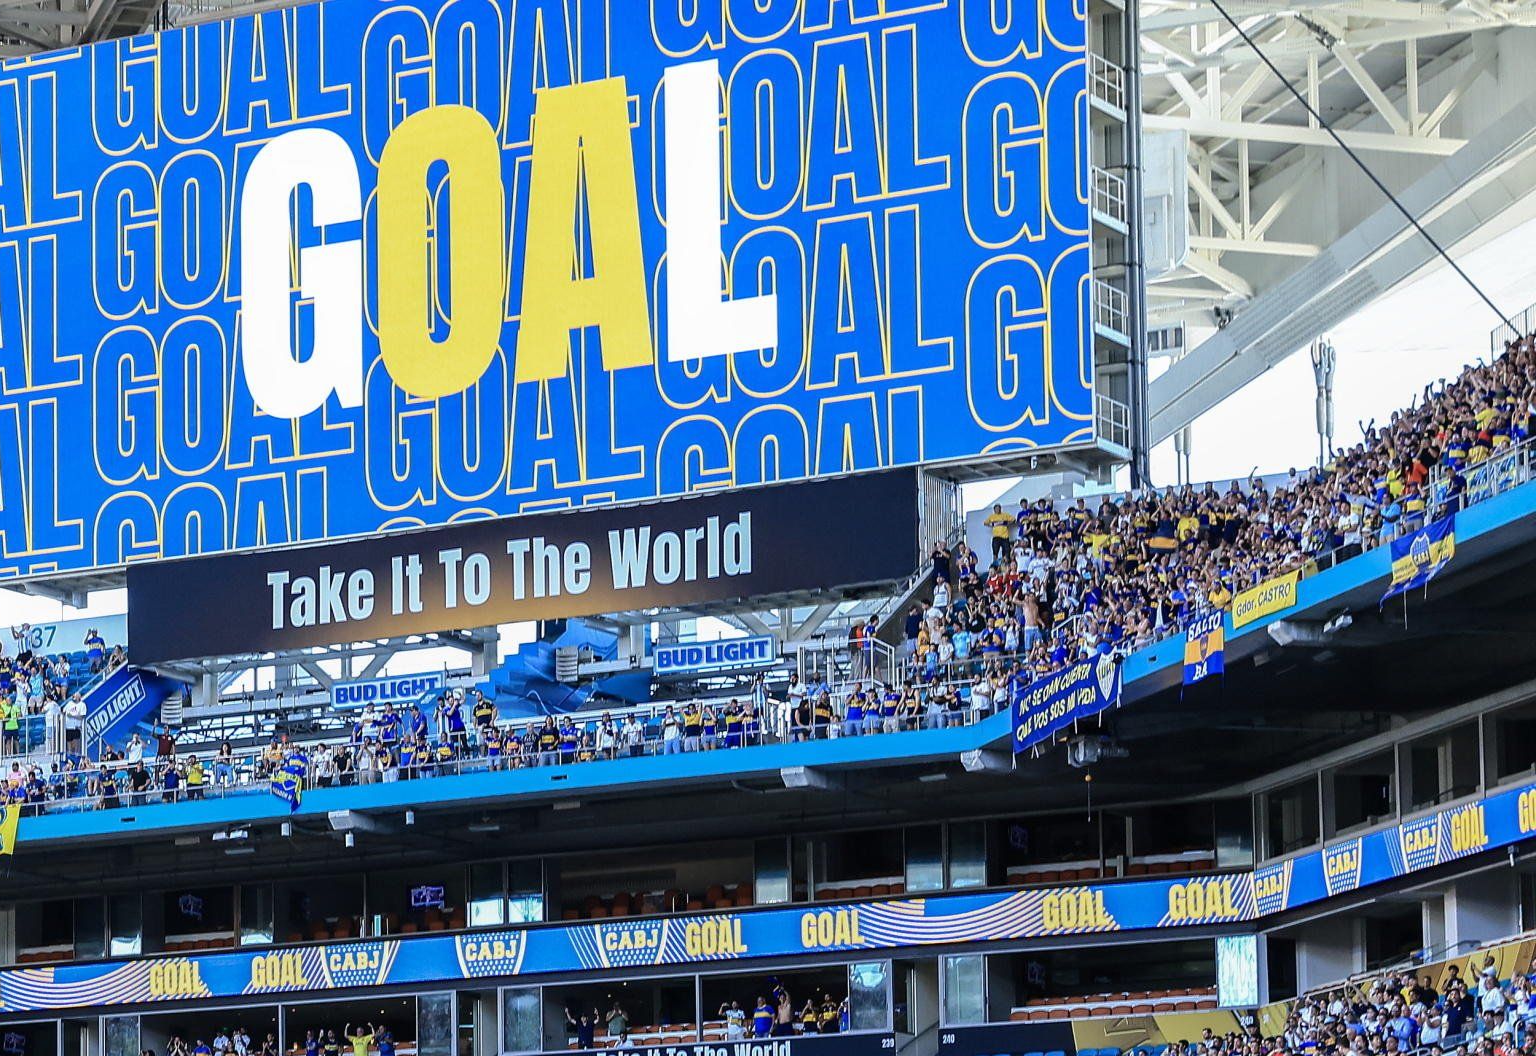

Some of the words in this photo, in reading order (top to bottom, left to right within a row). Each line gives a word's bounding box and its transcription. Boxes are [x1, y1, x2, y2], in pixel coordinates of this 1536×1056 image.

[241, 58, 778, 418] GOAL
[267, 563, 374, 630] Take
[392, 553, 422, 616] It
[439, 548, 490, 609] To
[506, 536, 591, 600] The
[608, 511, 753, 590] World
[1258, 582, 1291, 606] CASTRO
[31, 625, 56, 648] 37
[657, 648, 703, 668] BUD
[705, 640, 768, 662] LIGHT
[106, 679, 143, 721] LIGHT
[335, 684, 377, 704] BUD
[380, 676, 439, 699] LIGHT
[1033, 708, 1049, 730] VOS
[1049, 698, 1065, 721] SOS
[1076, 685, 1096, 706] VIDA
[1404, 824, 1438, 853] CABJ
[1451, 805, 1488, 852] GOAL
[1327, 850, 1358, 877] CABJ
[1169, 878, 1240, 920] GOAL
[1255, 873, 1284, 898] CABJ
[1042, 891, 1111, 931] GOAL
[604, 927, 658, 951] CABJ
[684, 917, 748, 957] GOAL
[801, 910, 865, 948] GOAL
[329, 950, 379, 971] CABJ
[464, 939, 517, 962] CABJ
[150, 961, 206, 996] GOAL
[251, 952, 308, 989] GOAL
